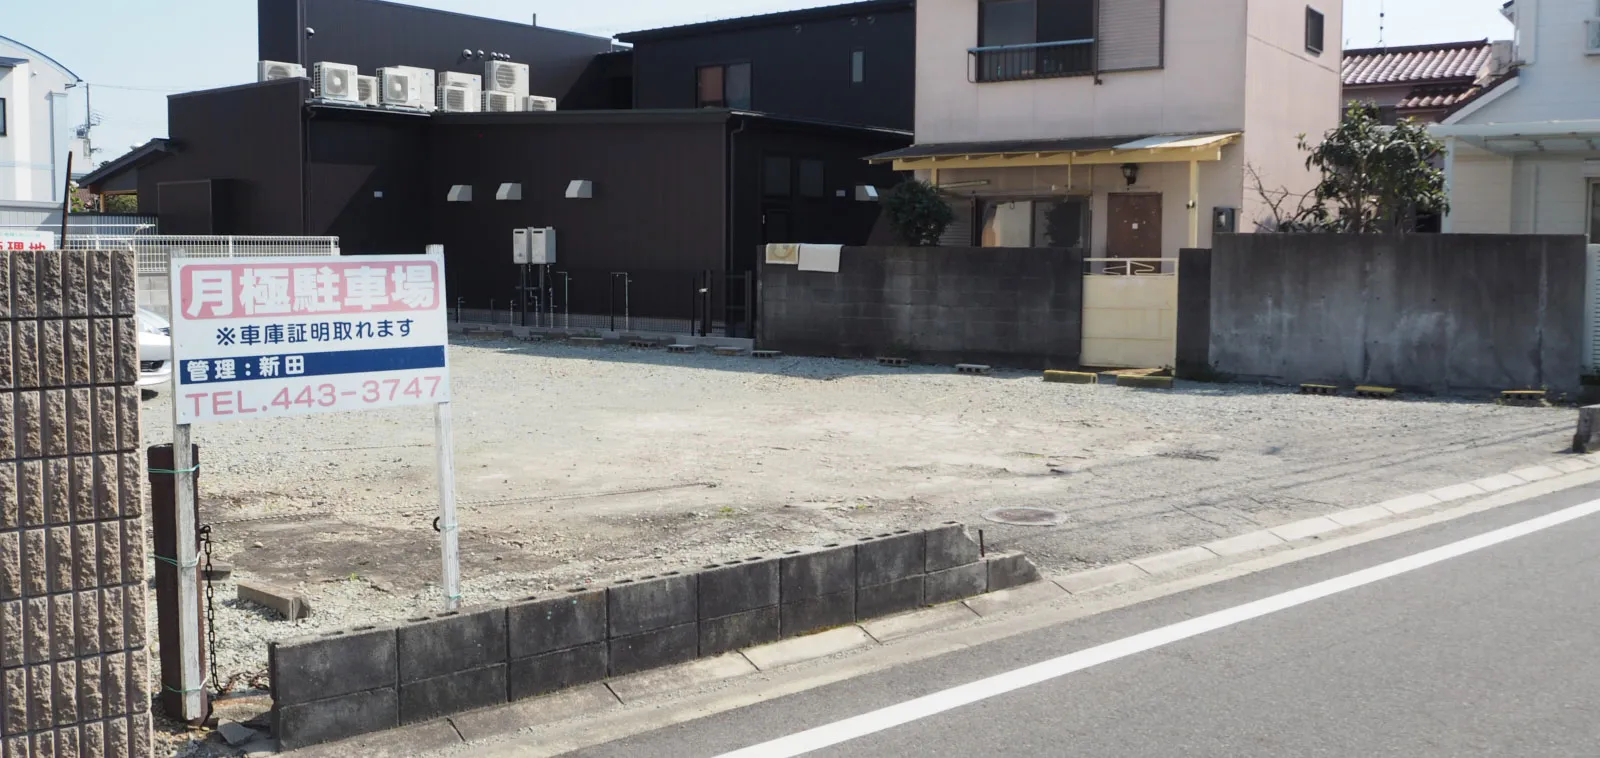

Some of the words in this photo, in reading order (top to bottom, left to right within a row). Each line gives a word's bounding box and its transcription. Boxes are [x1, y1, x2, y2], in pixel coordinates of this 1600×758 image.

[187, 265, 435, 317] 月極駐車場
[185, 375, 441, 417] TEL.443-3747
